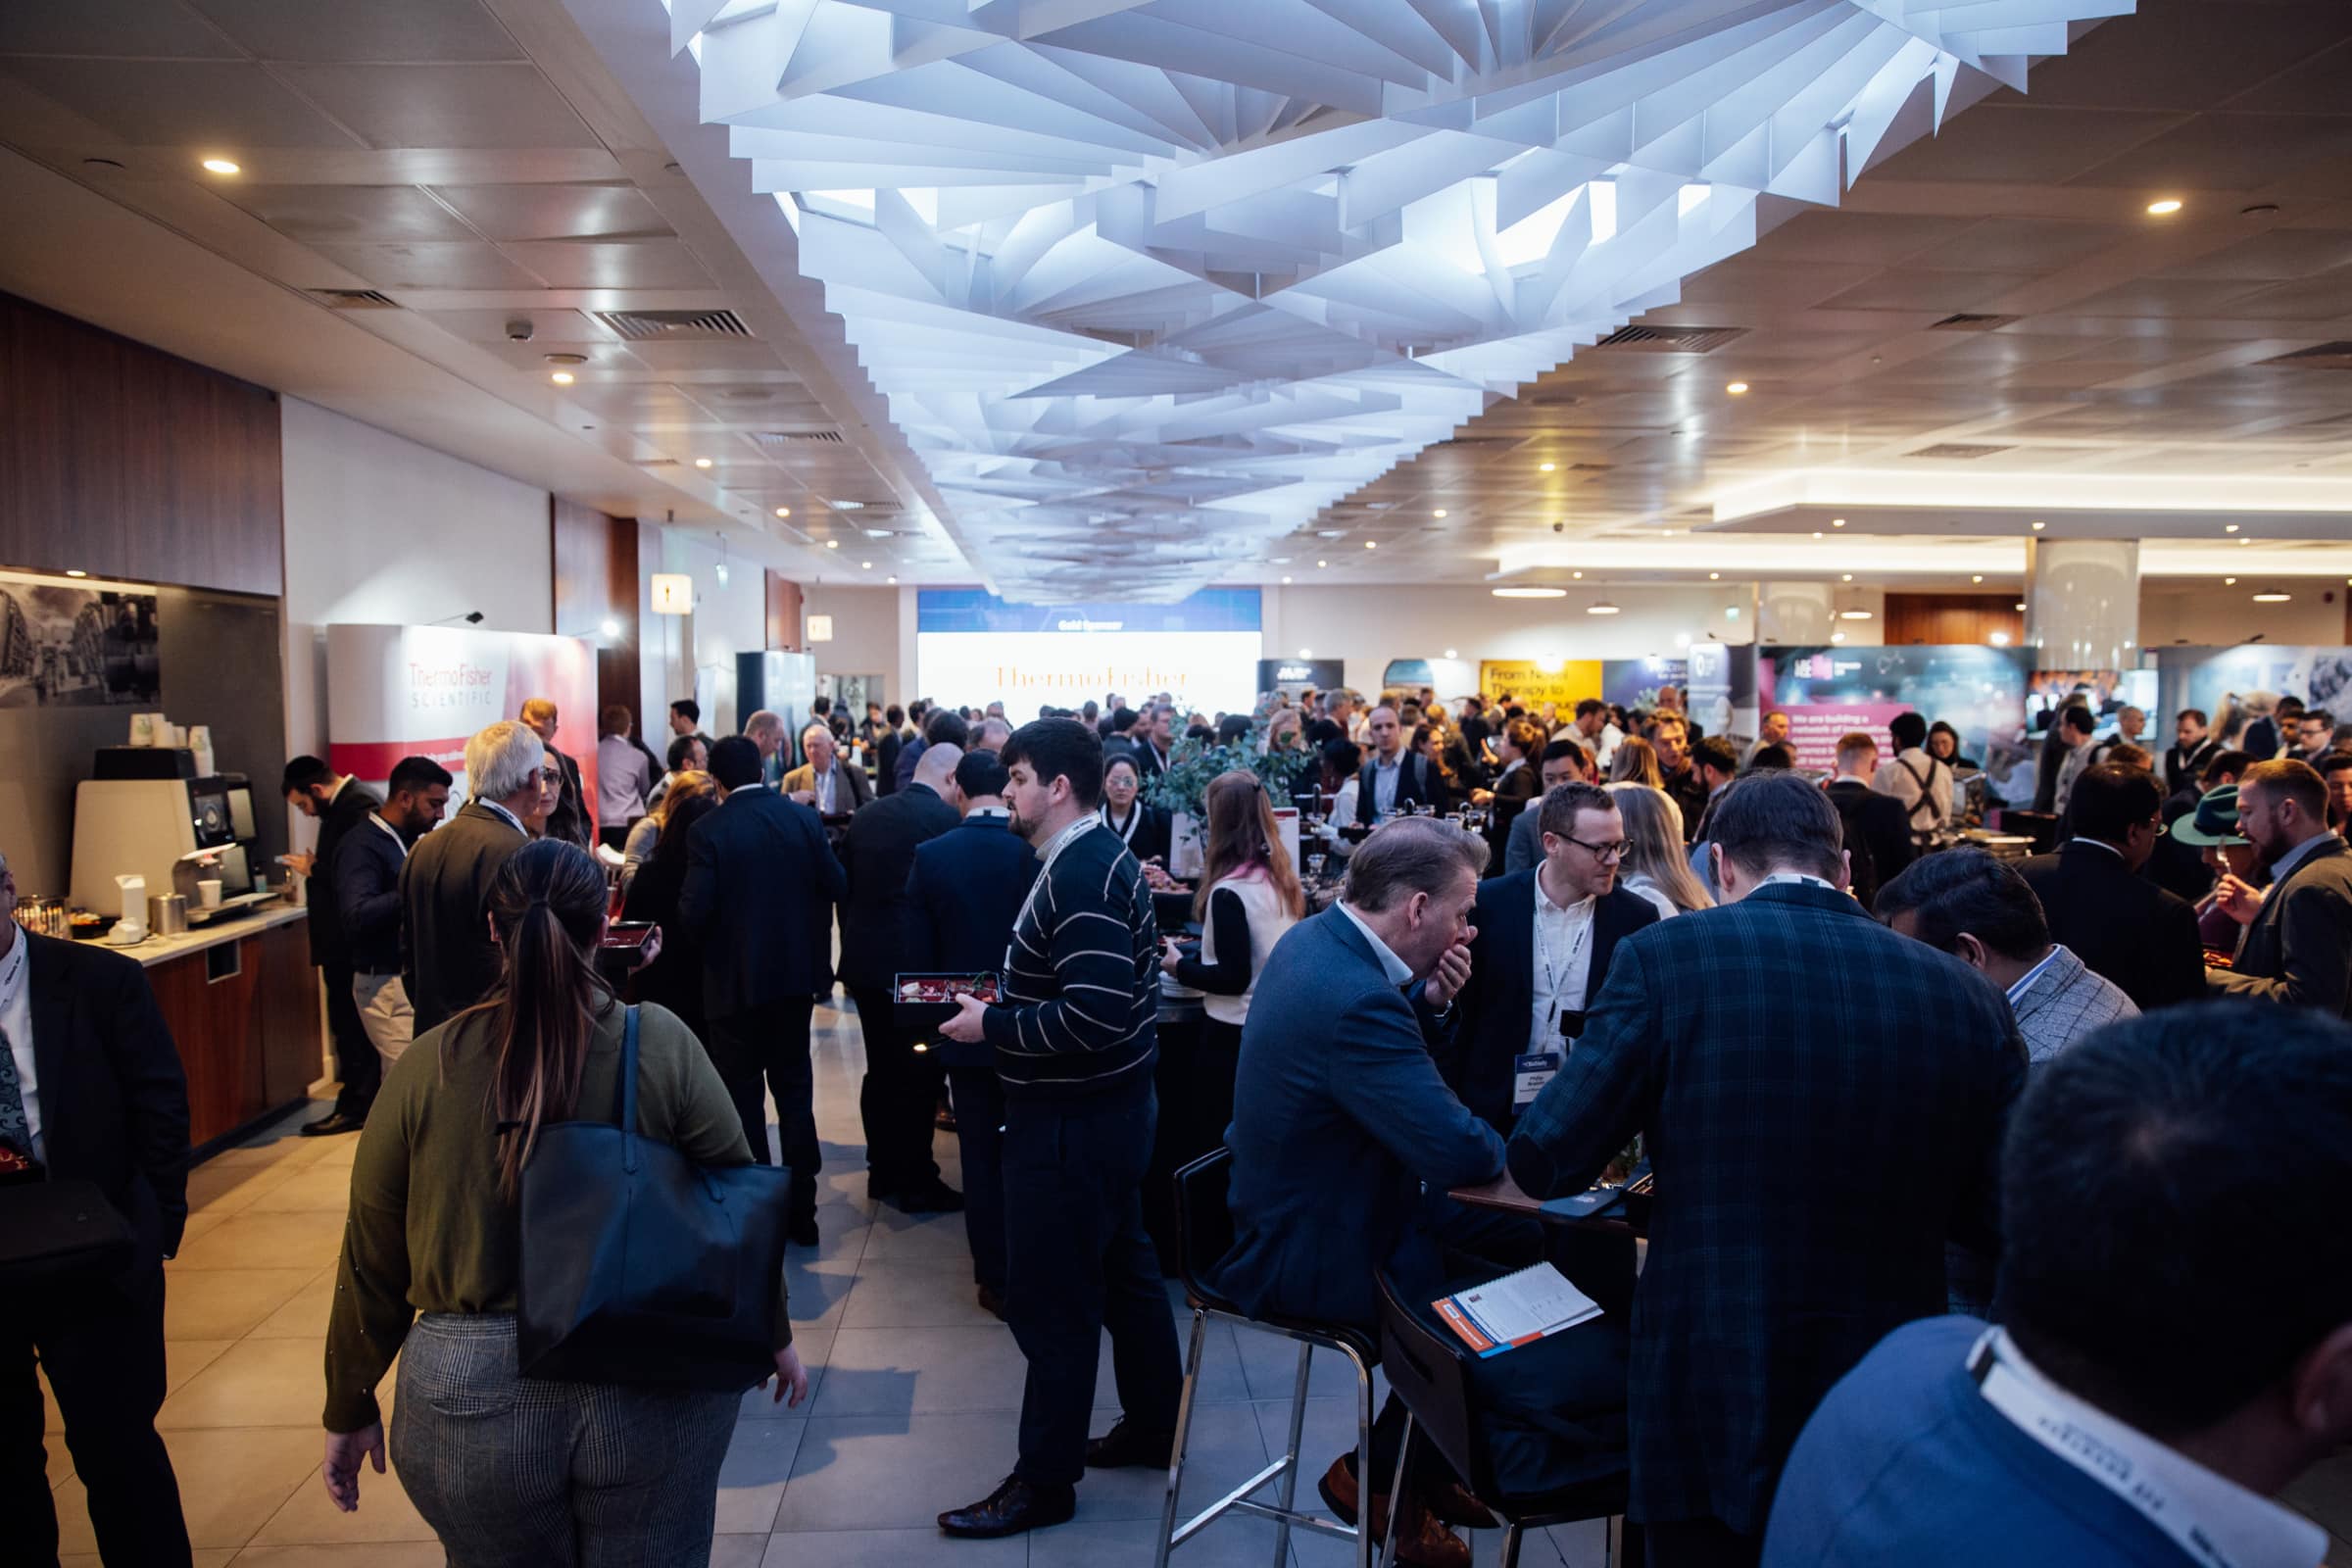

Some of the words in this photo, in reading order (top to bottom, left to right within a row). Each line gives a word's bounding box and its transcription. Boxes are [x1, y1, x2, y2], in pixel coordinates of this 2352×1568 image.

[408, 662, 492, 688] ThermoFisher
[1489, 667, 1526, 681] From
[412, 690, 492, 709] SCIENTIFIC
[1825, 713, 1860, 725] building
